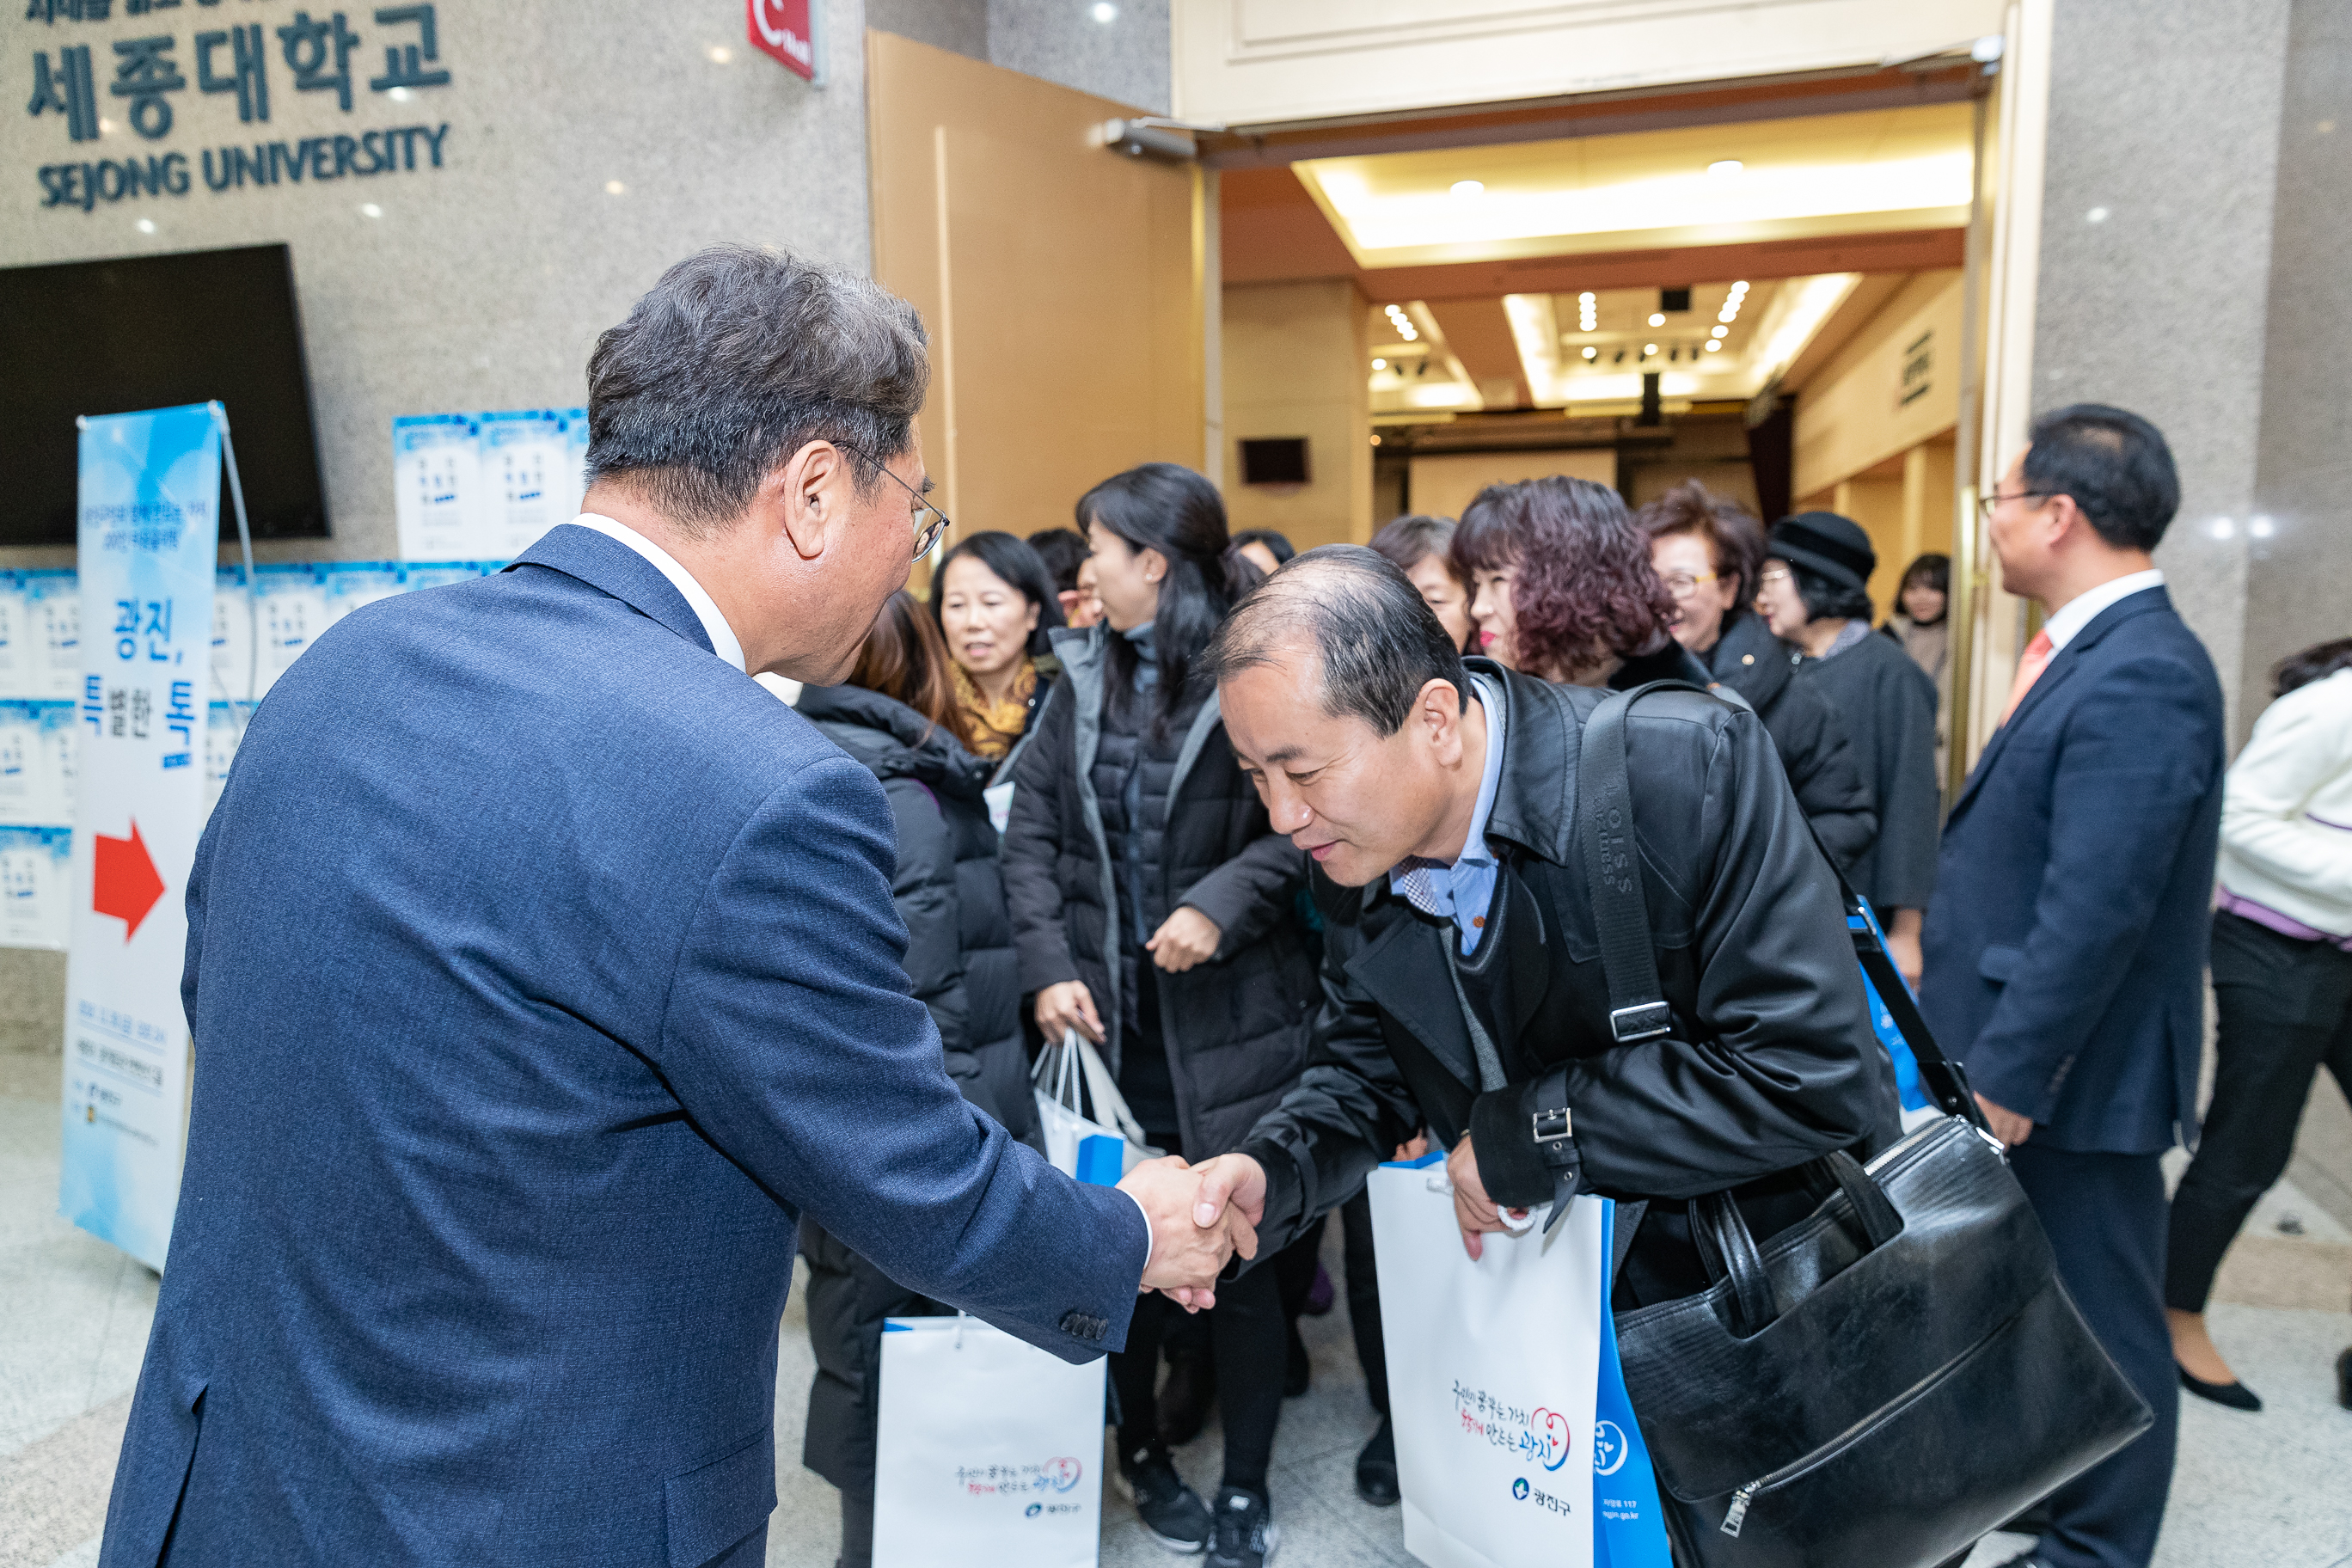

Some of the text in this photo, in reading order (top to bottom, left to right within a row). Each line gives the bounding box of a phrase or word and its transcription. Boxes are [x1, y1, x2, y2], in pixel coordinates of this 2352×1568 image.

[27, 3, 451, 143] 세종대학교
[38, 124, 449, 212] SEJONG UNIVERSITY
[113, 598, 183, 665] 광진,
[1486, 1423, 1518, 1453] 만드는
[1508, 1406, 1530, 1426] 가치
[1534, 1488, 1571, 1516] 광진구
